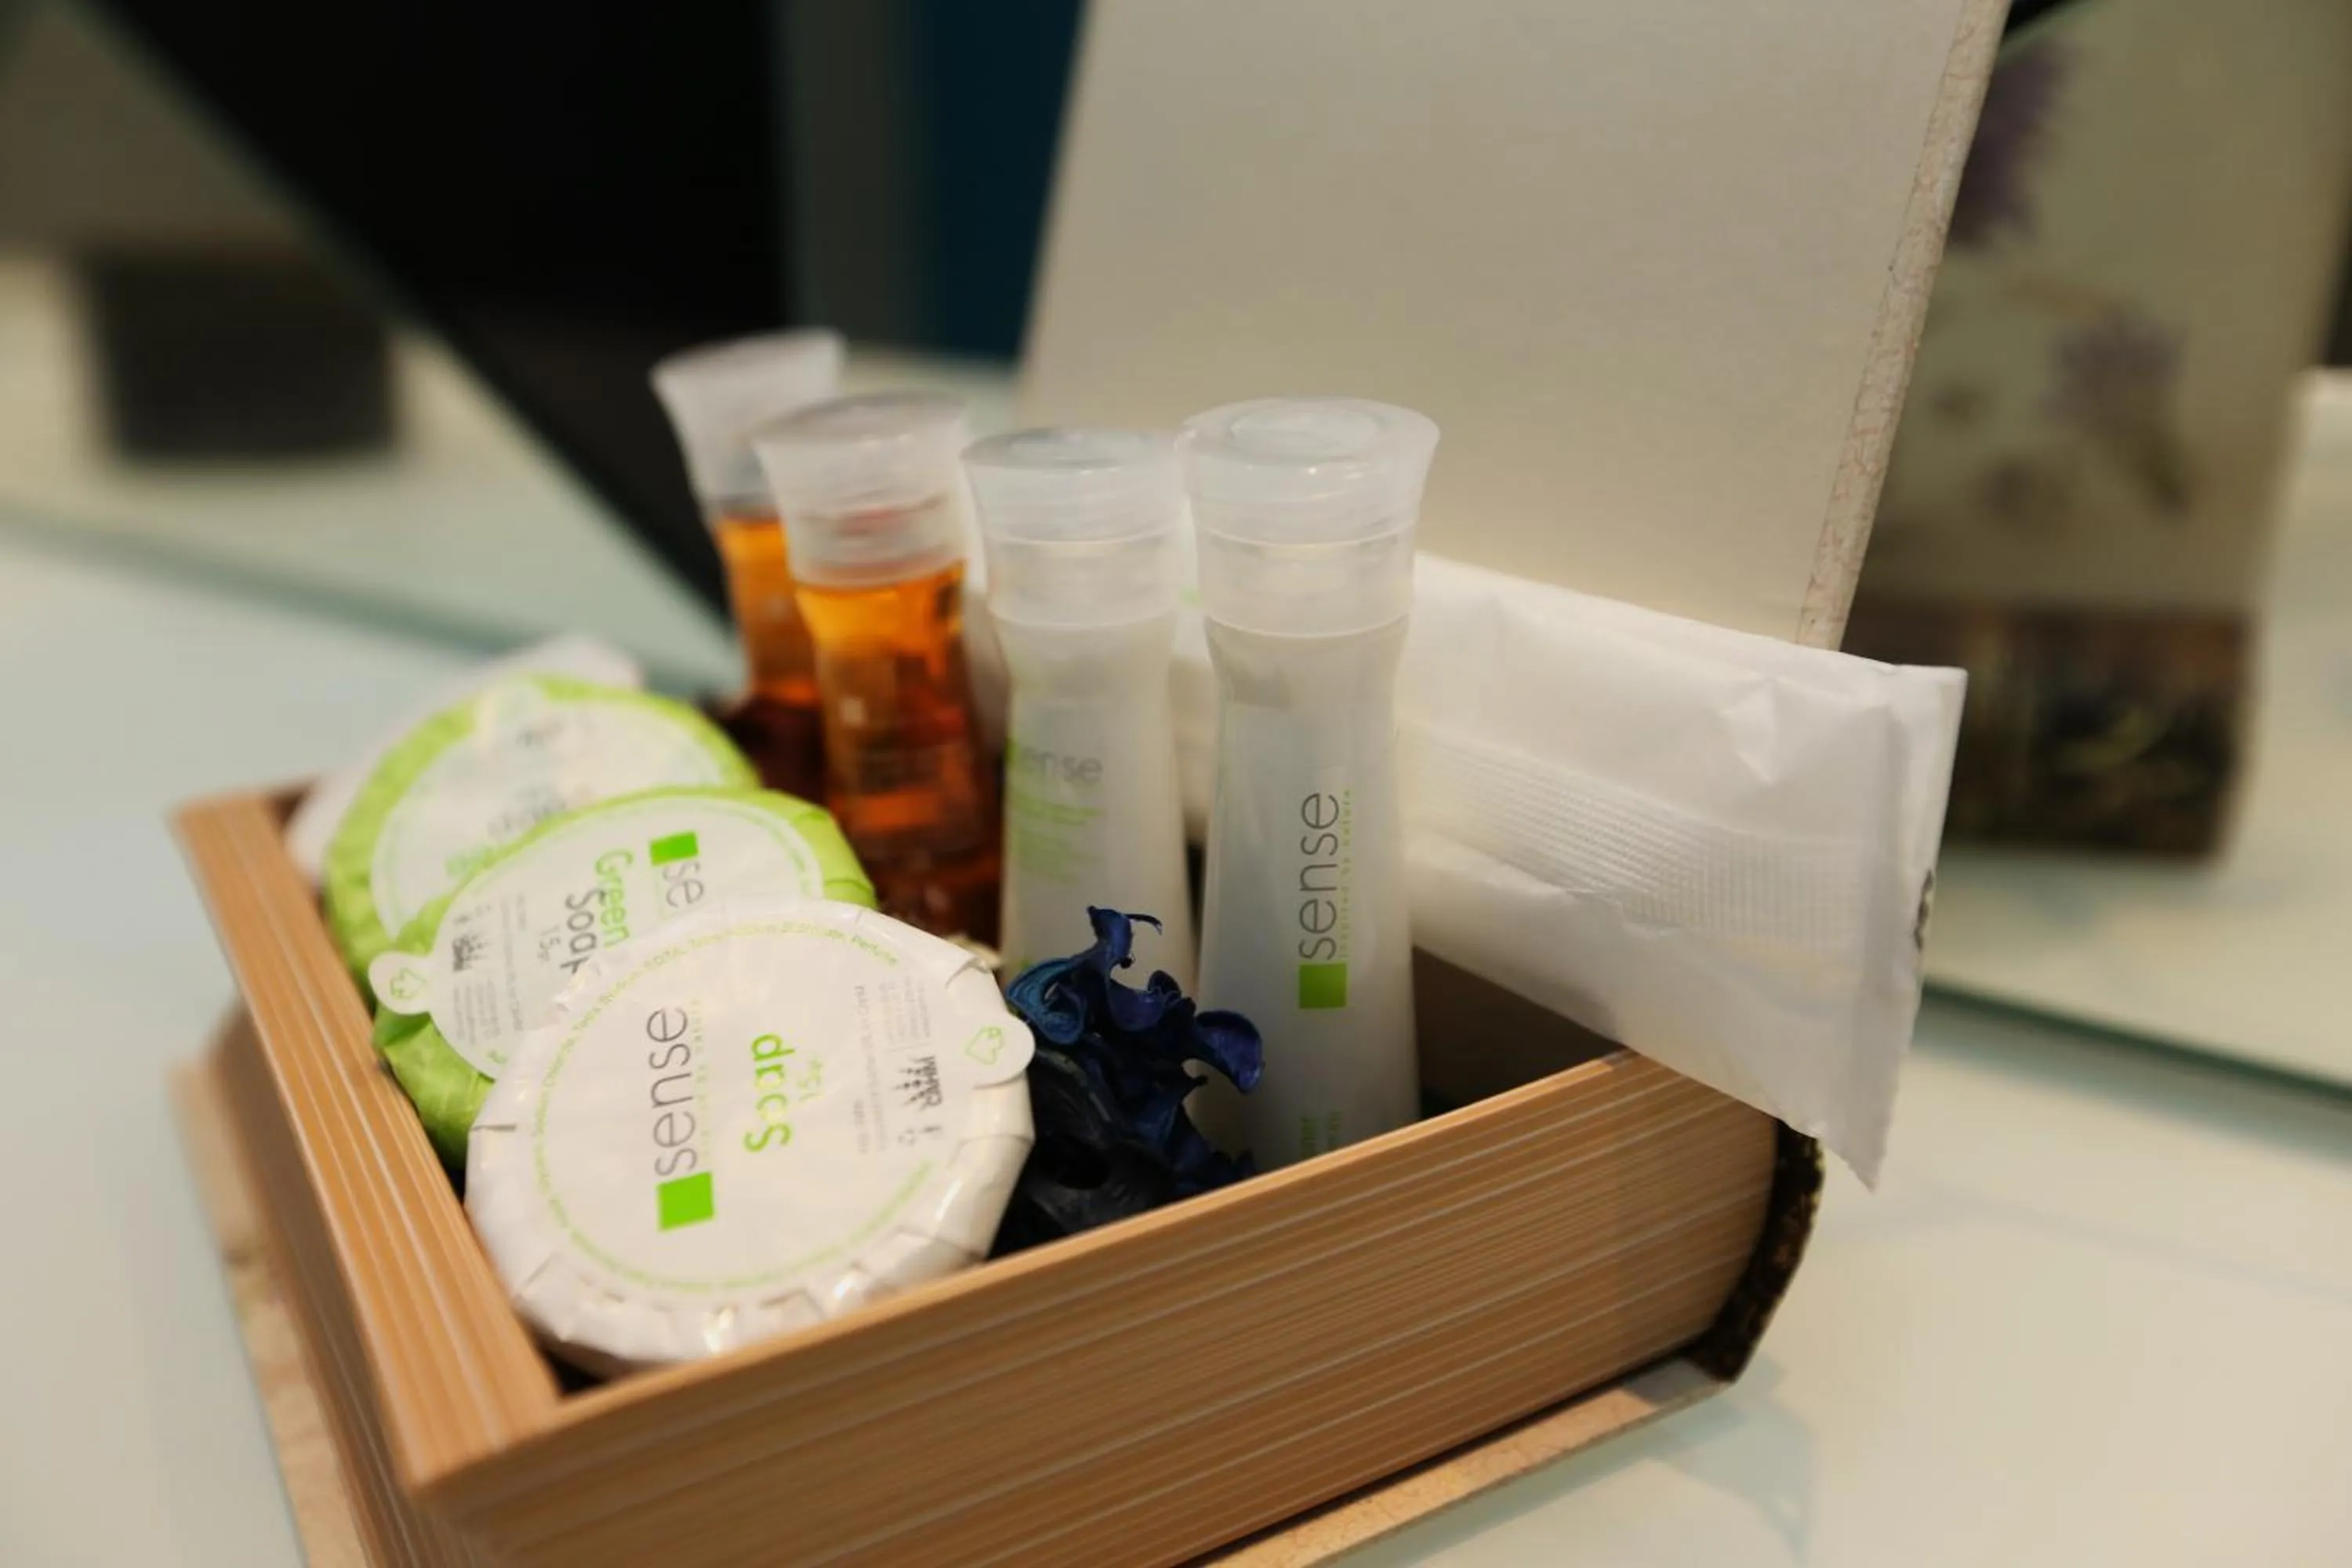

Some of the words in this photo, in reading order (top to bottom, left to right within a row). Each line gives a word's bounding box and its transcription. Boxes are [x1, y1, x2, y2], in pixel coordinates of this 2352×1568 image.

[594, 849, 633, 949] Green
[1298, 792, 1339, 960] sense
[645, 1007, 699, 1178] sense
[742, 1033, 796, 1152] Soap
